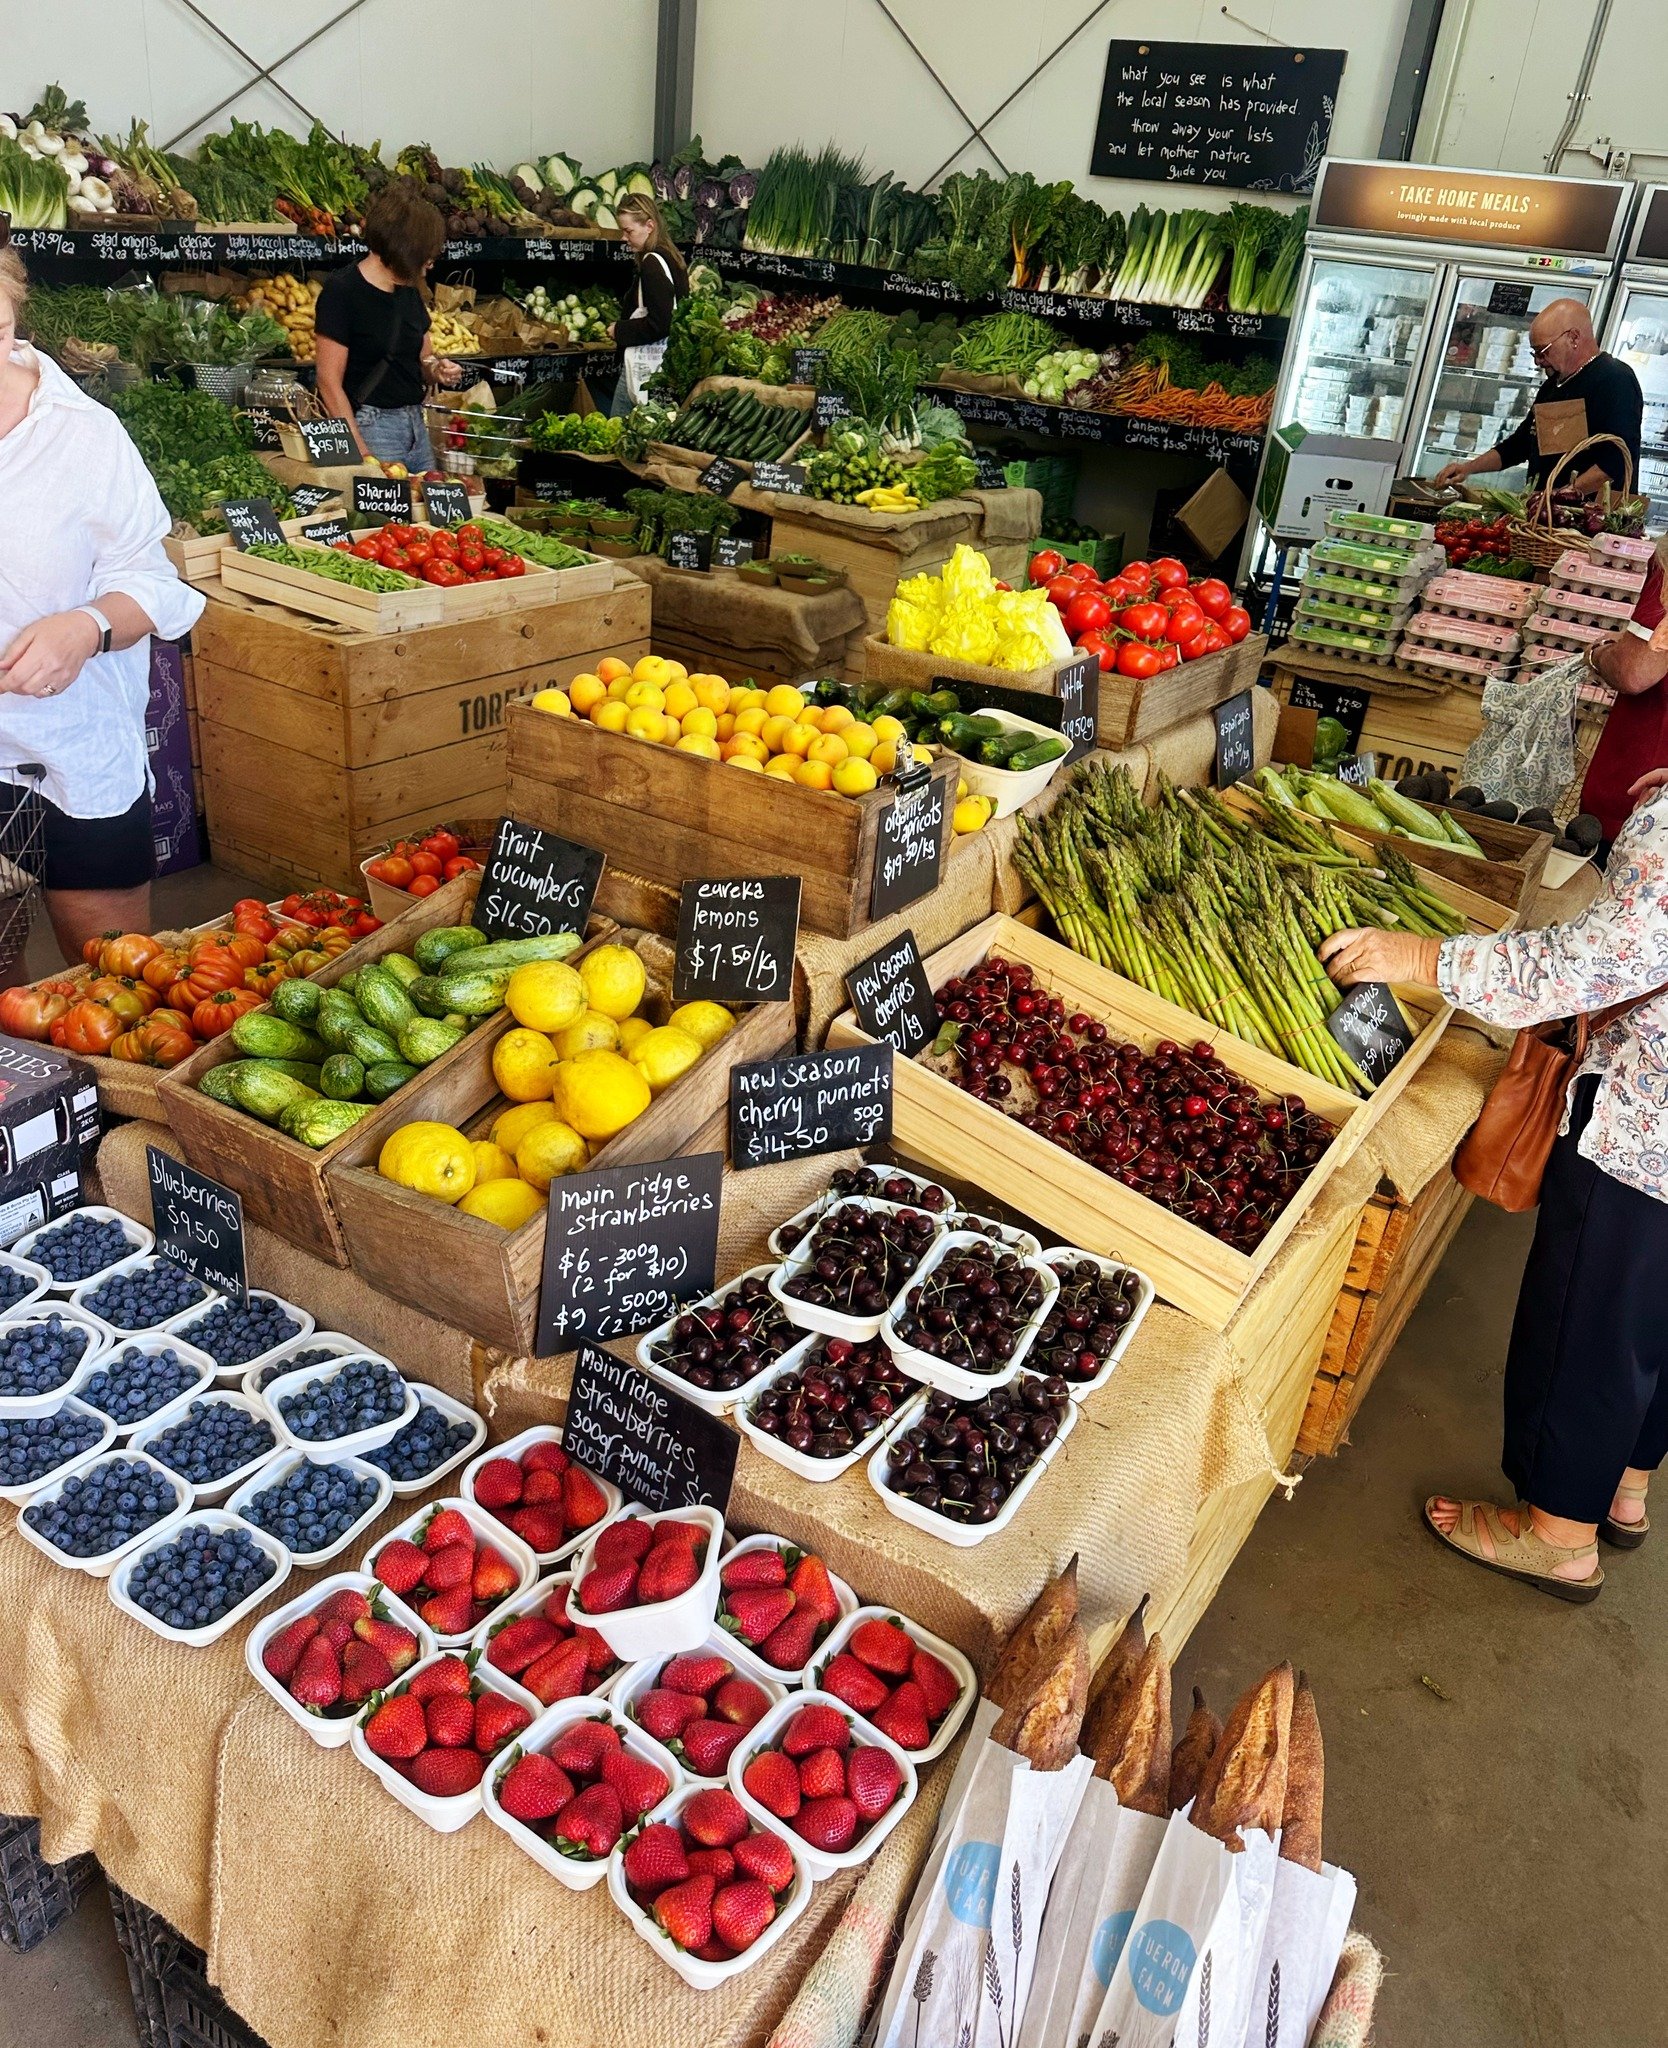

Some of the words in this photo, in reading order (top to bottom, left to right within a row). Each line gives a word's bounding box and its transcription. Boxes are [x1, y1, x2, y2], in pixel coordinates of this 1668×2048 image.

[1122, 66, 1148, 83] what
[1156, 71, 1180, 89] you
[1189, 73, 1207, 86] see
[1221, 75, 1233, 88] is
[1243, 72, 1276, 92] what
[1117, 92, 1134, 107] the
[1141, 92, 1167, 109] local
[1174, 94, 1211, 108] season
[1219, 95, 1241, 112] has
[1131, 118, 1160, 135] throw
[1171, 123, 1202, 144] away
[1206, 129, 1235, 144] your
[1247, 127, 1274, 143] lists
[1108, 143, 1127, 155] and
[1137, 141, 1154, 158] let
[1160, 146, 1200, 160] mother
[1210, 149, 1252, 164] nature
[1166, 164, 1196, 180] guide
[1400, 185, 1434, 205] TAKE
[1437, 188, 1478, 209] HOME
[1481, 192, 1531, 213] MEALS
[1397, 211, 1428, 223] lovingly
[1429, 215, 1449, 223] made
[1450, 215, 1468, 225] with
[1469, 217, 1488, 227] local
[1489, 220, 1521, 230] produce
[100, 247, 114, 259] $2
[122, 235, 157, 249] onions
[179, 235, 216, 249] celeriac
[252, 234, 285, 250] broccoli
[1114, 299, 1141, 318] leeks
[1172, 309, 1215, 324] rhubarb
[1226, 313, 1262, 330] celery
[1184, 430, 1219, 447] dutch
[1222, 432, 1260, 455] carrots
[357, 482, 401, 500] Sharwil
[357, 499, 409, 513] avocados
[885, 799, 925, 842] organic
[900, 796, 942, 848] apricots
[498, 819, 545, 864] fruit
[884, 836, 936, 886] $19.50/kg
[492, 861, 585, 908] cucumbers
[697, 881, 765, 901] eureka
[485, 887, 551, 937] $16.50
[693, 902, 760, 931] lemons
[689, 935, 778, 991] $7.50/kg
[856, 961, 881, 1005] new
[879, 942, 915, 984] season
[875, 976, 915, 1027] cherries
[739, 1068, 775, 1093] new
[781, 1055, 861, 1088] season
[77, 1083, 91, 1094] CLASS
[739, 1096, 802, 1135] cherry
[817, 1065, 890, 1115] punnets
[81, 1115, 95, 1128] 2KG
[747, 1126, 828, 1162] $14.50
[853, 1103, 884, 1122] 500
[57, 1169, 71, 1179] CLASS
[627, 1172, 691, 1204] ridge
[60, 1200, 75, 1212] 2KG
[567, 1192, 714, 1236] strawberries
[167, 1198, 220, 1250] $9.50
[558, 1246, 591, 1279] $6
[613, 1242, 659, 1267] 300g
[572, 1275, 595, 1298] (2
[603, 1267, 637, 1296] for
[647, 1246, 688, 1280] $10)
[205, 1266, 243, 1295] punnet
[553, 1303, 587, 1335] $9
[618, 1289, 668, 1313] 500g
[597, 1315, 624, 1336] (2
[629, 1312, 657, 1333] for
[620, 1444, 676, 1490] punnet
[616, 1464, 670, 1510] punnet
[953, 1889, 989, 1914] FAR
[1136, 1929, 1189, 1982] TUERON
[1138, 1966, 1174, 2008] FARM
